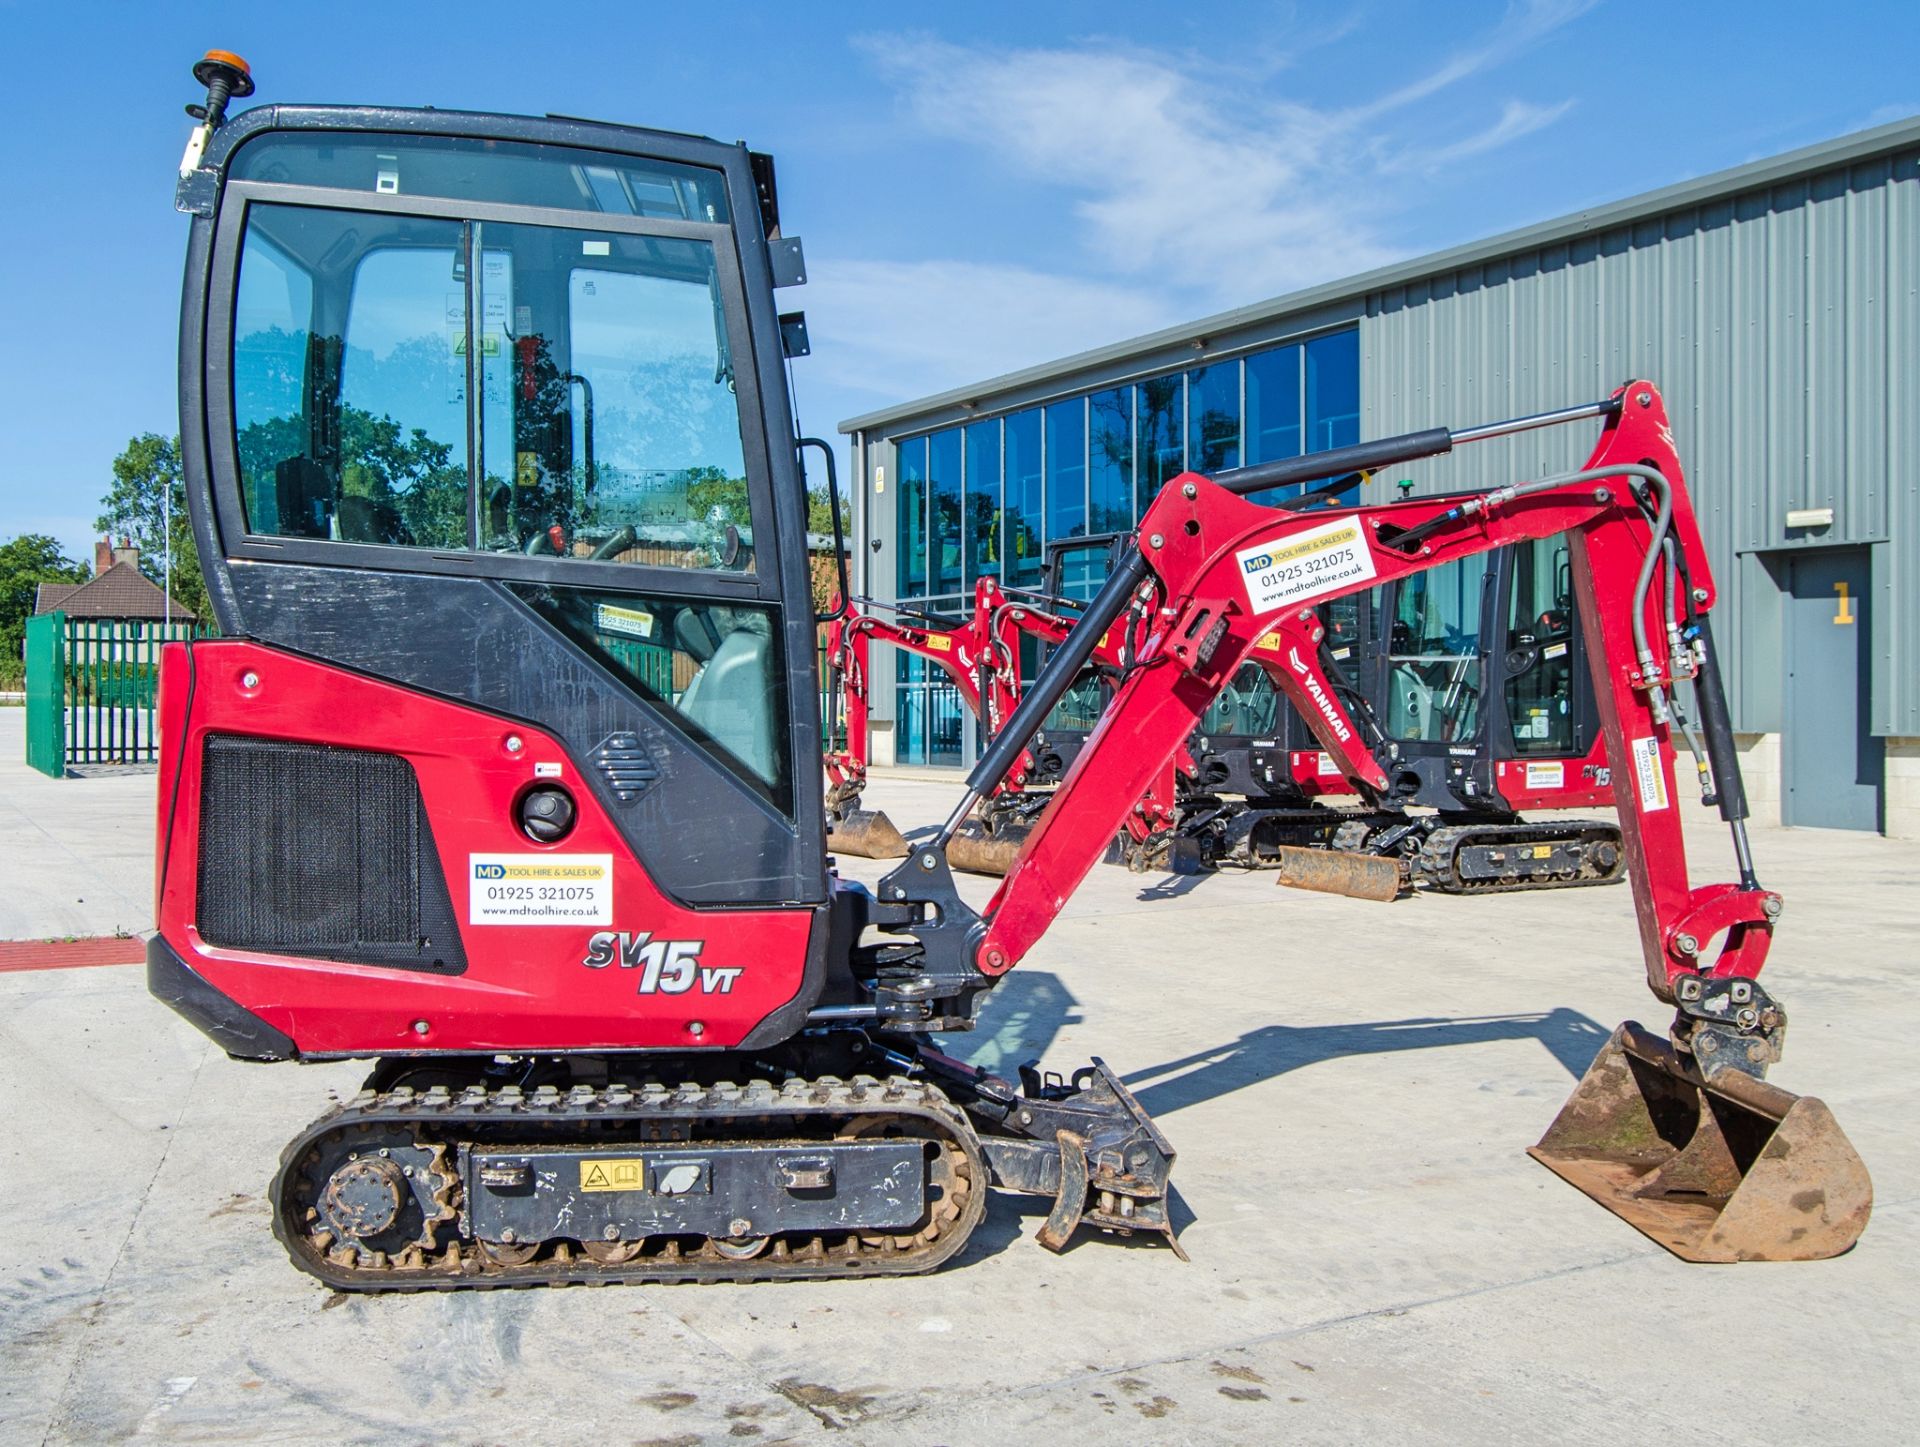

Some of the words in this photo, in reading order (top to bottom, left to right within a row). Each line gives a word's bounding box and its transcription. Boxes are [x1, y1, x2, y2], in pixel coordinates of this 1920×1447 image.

[1246, 556, 1270, 572] MD
[1273, 551, 1294, 561] TOOL
[1295, 544, 1312, 555] HIRE
[1312, 542, 1319, 550] &
[1319, 535, 1342, 547] SALES
[1342, 531, 1354, 540] UK
[1261, 565, 1303, 588] 01925
[1304, 548, 1355, 574] 321075
[1261, 563, 1364, 603] www.mdtoolhire.co.uk
[1833, 582, 1855, 625] 1
[1304, 672, 1351, 743] YANMAR
[477, 865, 502, 878] MD
[508, 868, 530, 877] TOOL
[532, 868, 553, 877] HIRE
[553, 868, 561, 877] &
[562, 868, 587, 877] SALES
[588, 868, 601, 877] UK
[482, 905, 600, 917] www.mdtoolhire.co.uk
[487, 887, 534, 900] 01925
[538, 887, 595, 900] 321075
